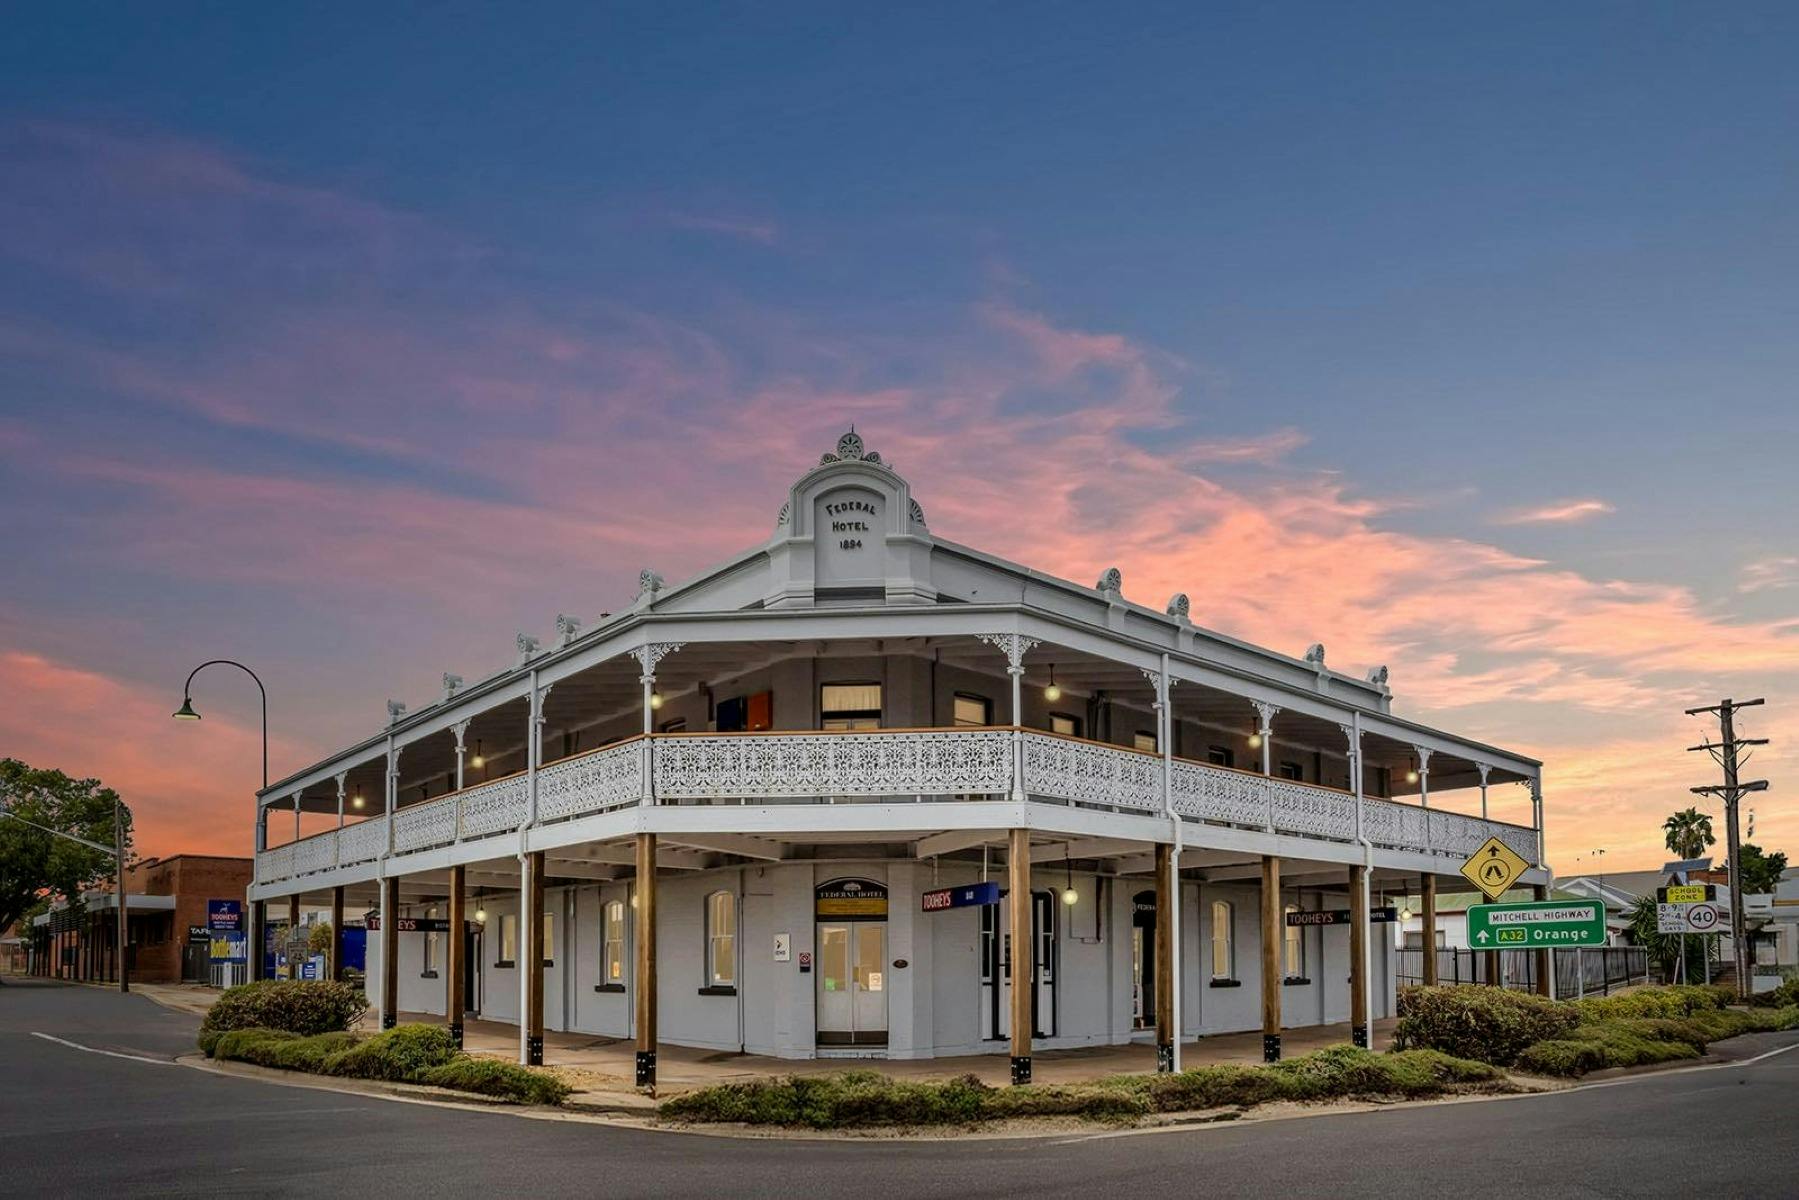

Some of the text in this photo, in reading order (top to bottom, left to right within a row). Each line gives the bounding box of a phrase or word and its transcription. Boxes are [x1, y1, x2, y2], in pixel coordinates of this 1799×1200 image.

[825, 501, 875, 516] FEDERAL
[832, 521, 869, 531] HOTEL
[840, 539, 862, 549] 1894
[923, 891, 951, 909] TOOHEYS
[1290, 912, 1334, 924] TOOHEYS
[1492, 910, 1590, 922] MITCHELL HIGHWAY
[1692, 911, 1713, 922] 40
[1500, 929, 1589, 941] A32 Orange
